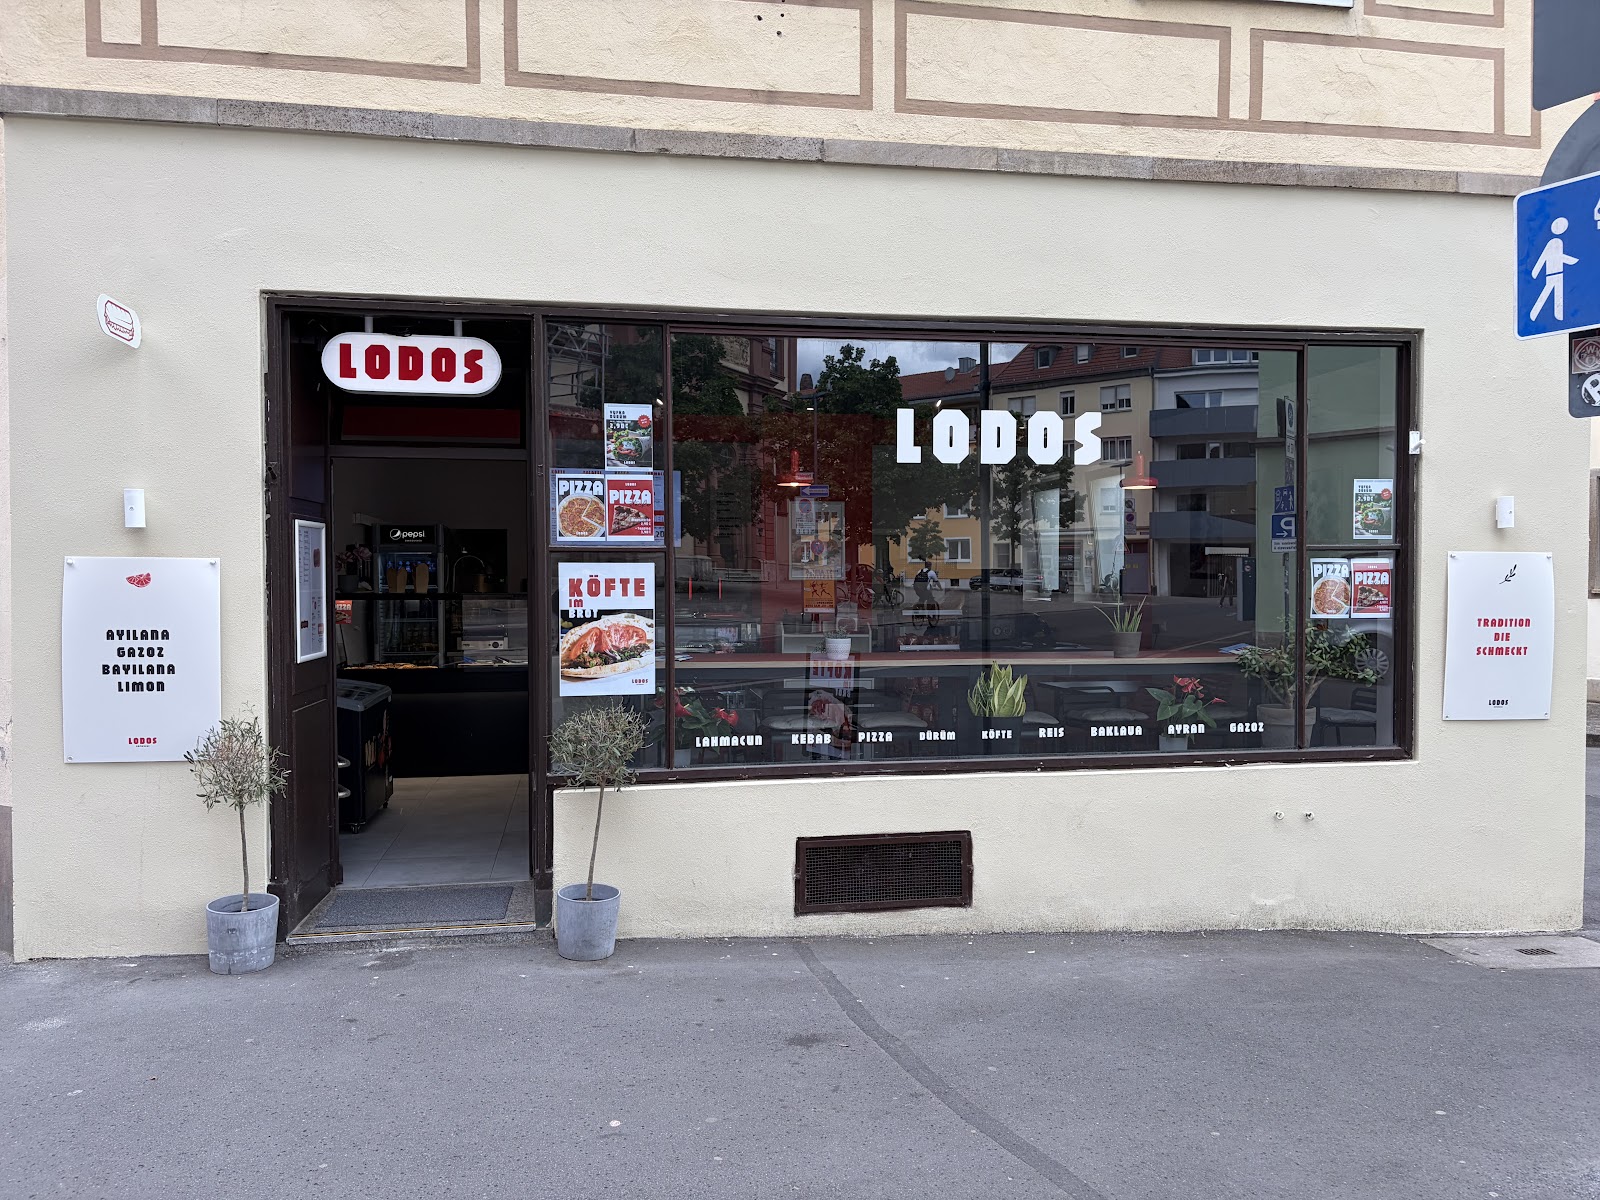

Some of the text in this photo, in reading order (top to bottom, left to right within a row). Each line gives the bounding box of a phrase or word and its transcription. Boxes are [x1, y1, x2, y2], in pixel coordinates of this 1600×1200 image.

[339, 343, 484, 384] LODOS
[896, 408, 1102, 466] LODOS
[559, 480, 604, 495] PIZZA
[609, 490, 652, 504] PIZZA
[402, 530, 425, 539] pepsi
[1313, 563, 1349, 578] PIZZA
[1355, 572, 1389, 585] PIZZA
[568, 575, 645, 597] KÖFTE
[569, 599, 583, 608] IM
[1477, 618, 1531, 628] TRADITION
[106, 629, 170, 641] AYILANA
[1494, 632, 1511, 642] DIE
[116, 647, 164, 658] GAZOZ
[1476, 646, 1528, 656] SCHMECKT
[102, 664, 175, 675] BAYILANA
[117, 681, 165, 692] LIMON
[695, 735, 763, 748] LAHMACUN
[791, 733, 832, 745] KEBAB
[858, 731, 894, 743] PIZZA
[919, 729, 957, 741] DÜRÜM
[981, 728, 1013, 740] KÖFTE
[1038, 727, 1065, 738] REIS
[1167, 723, 1206, 735] AYRAN
[1229, 722, 1265, 733] GAZOZ
[128, 737, 157, 745] LODOS
